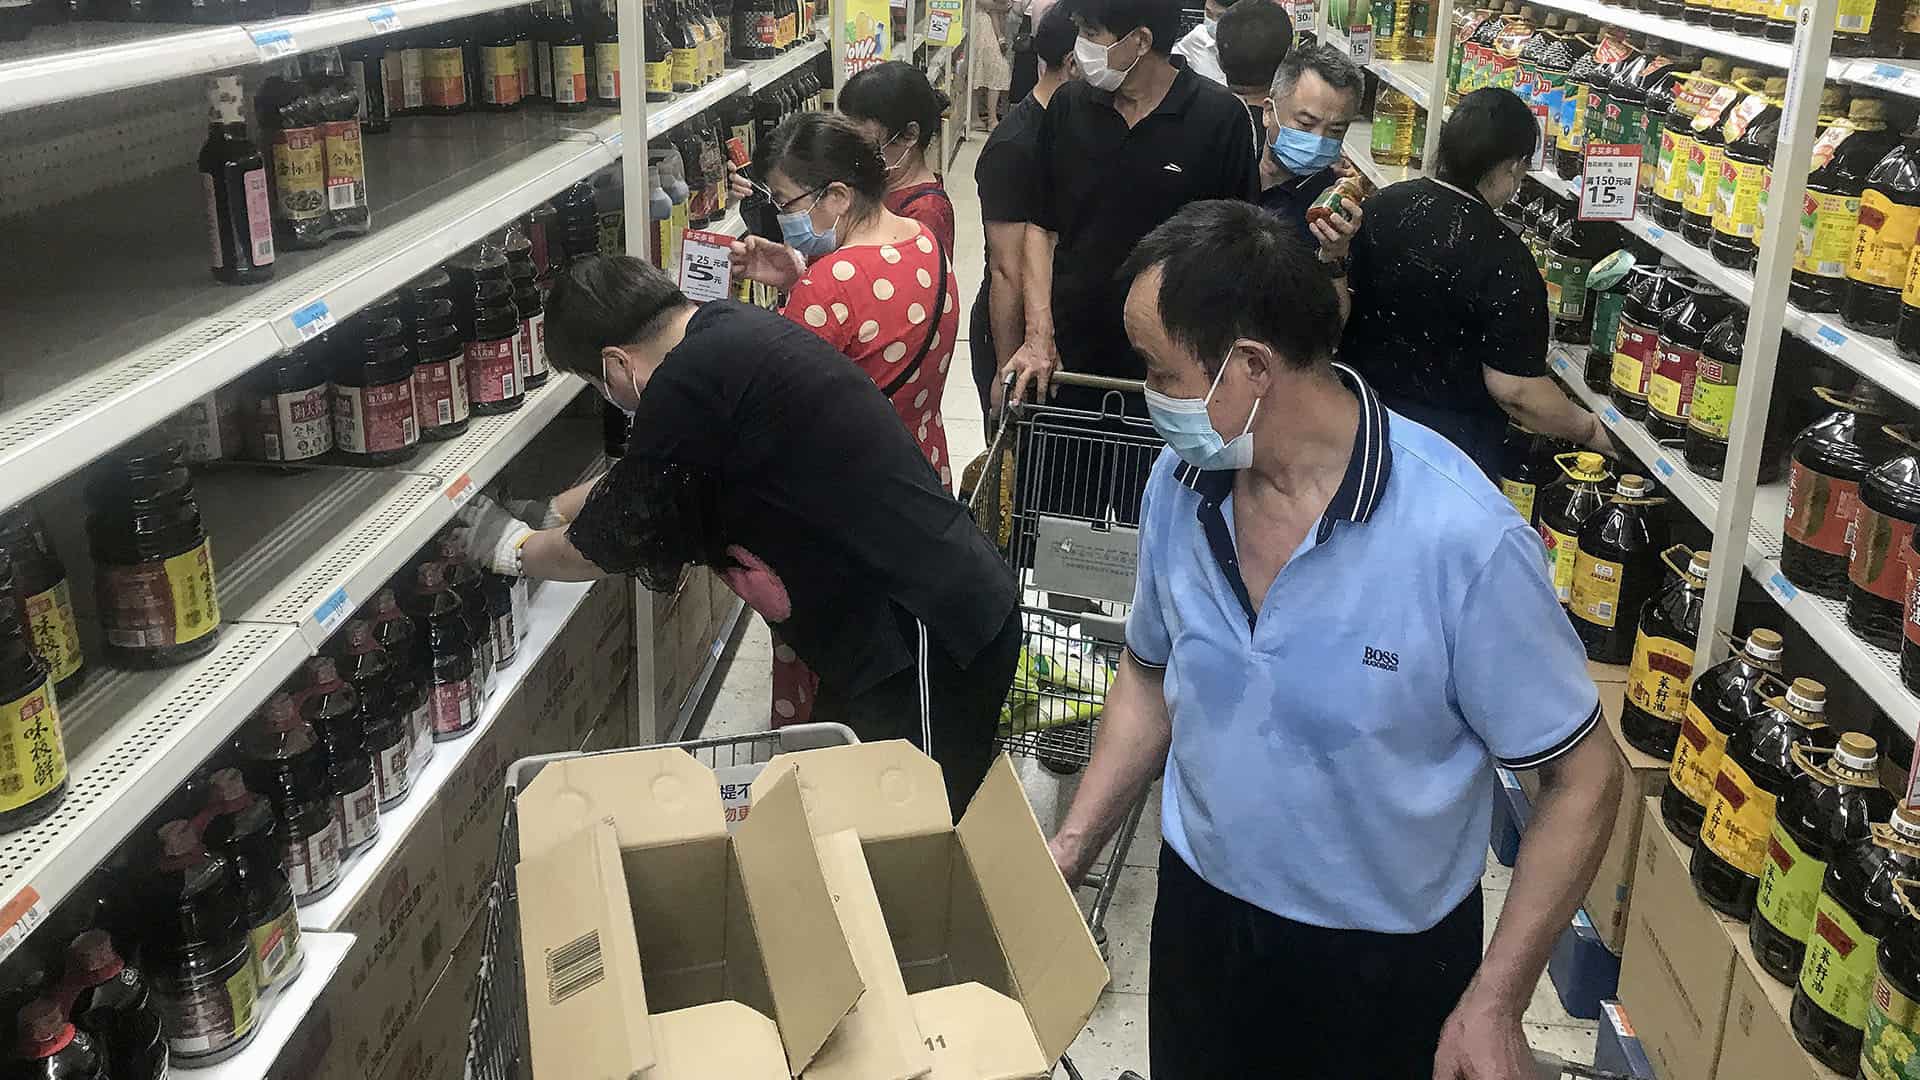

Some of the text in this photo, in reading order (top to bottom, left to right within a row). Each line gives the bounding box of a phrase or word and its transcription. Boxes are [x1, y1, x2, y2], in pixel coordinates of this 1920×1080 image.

[1364, 645, 1399, 666] BOSS
[1653, 675, 1671, 713] 菜籽油
[1811, 946, 1831, 995] 菜籽油
[924, 1034, 947, 1051] 11
